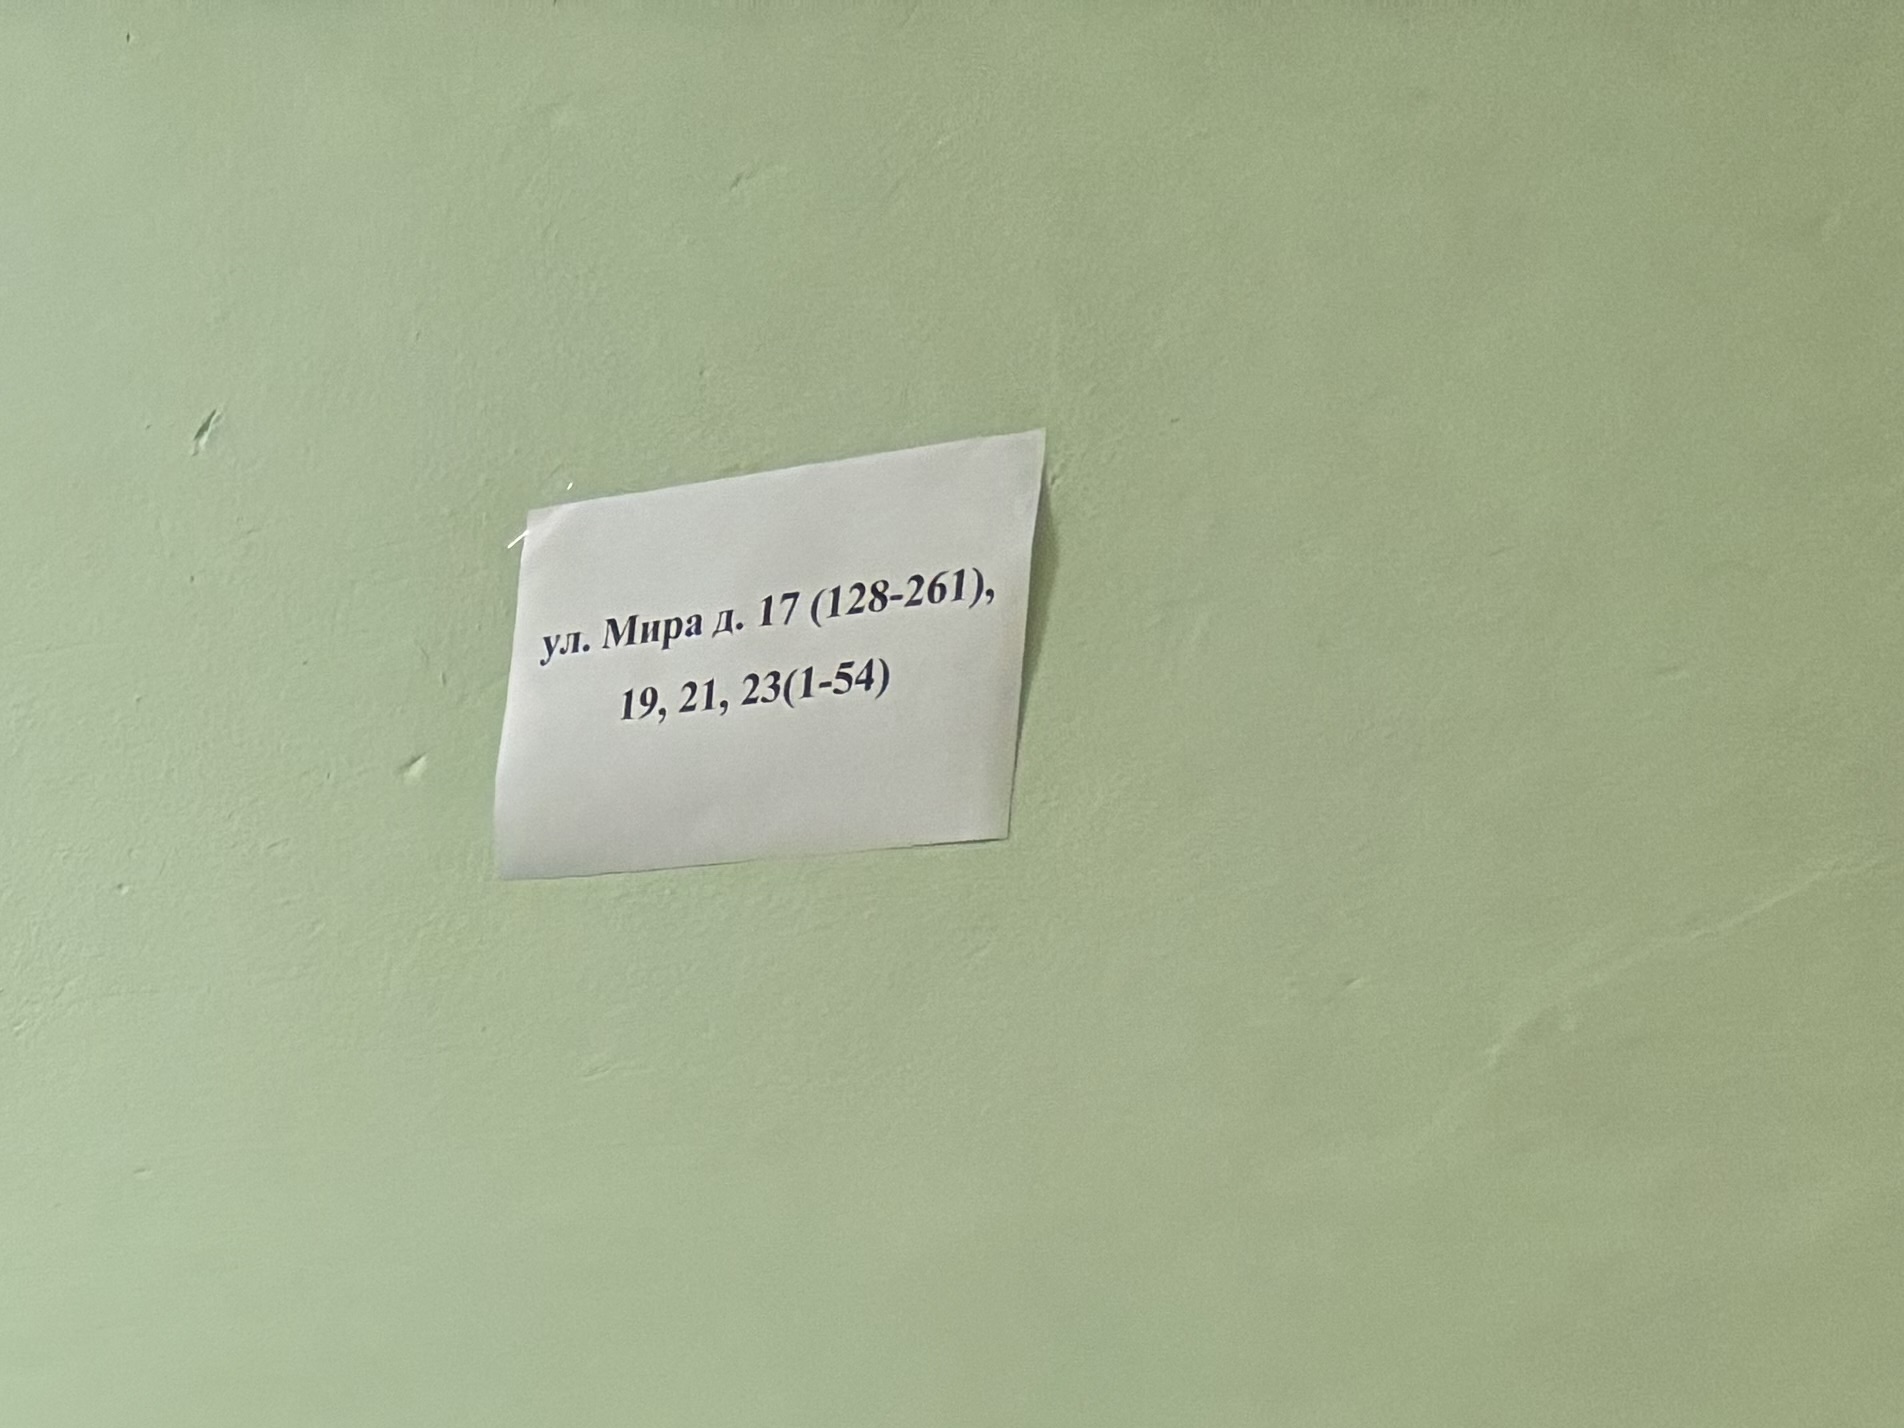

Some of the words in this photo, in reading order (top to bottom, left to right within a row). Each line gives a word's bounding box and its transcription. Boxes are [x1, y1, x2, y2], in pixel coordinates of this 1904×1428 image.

[540, 629, 590, 666] ул.
[602, 610, 703, 653] Мира
[712, 604, 745, 640] д.
[758, 590, 799, 629] 17
[810, 566, 996, 630] (128-261),
[620, 683, 667, 724] 19,
[678, 676, 730, 719] 21,
[741, 657, 890, 712] 23(1-54)
